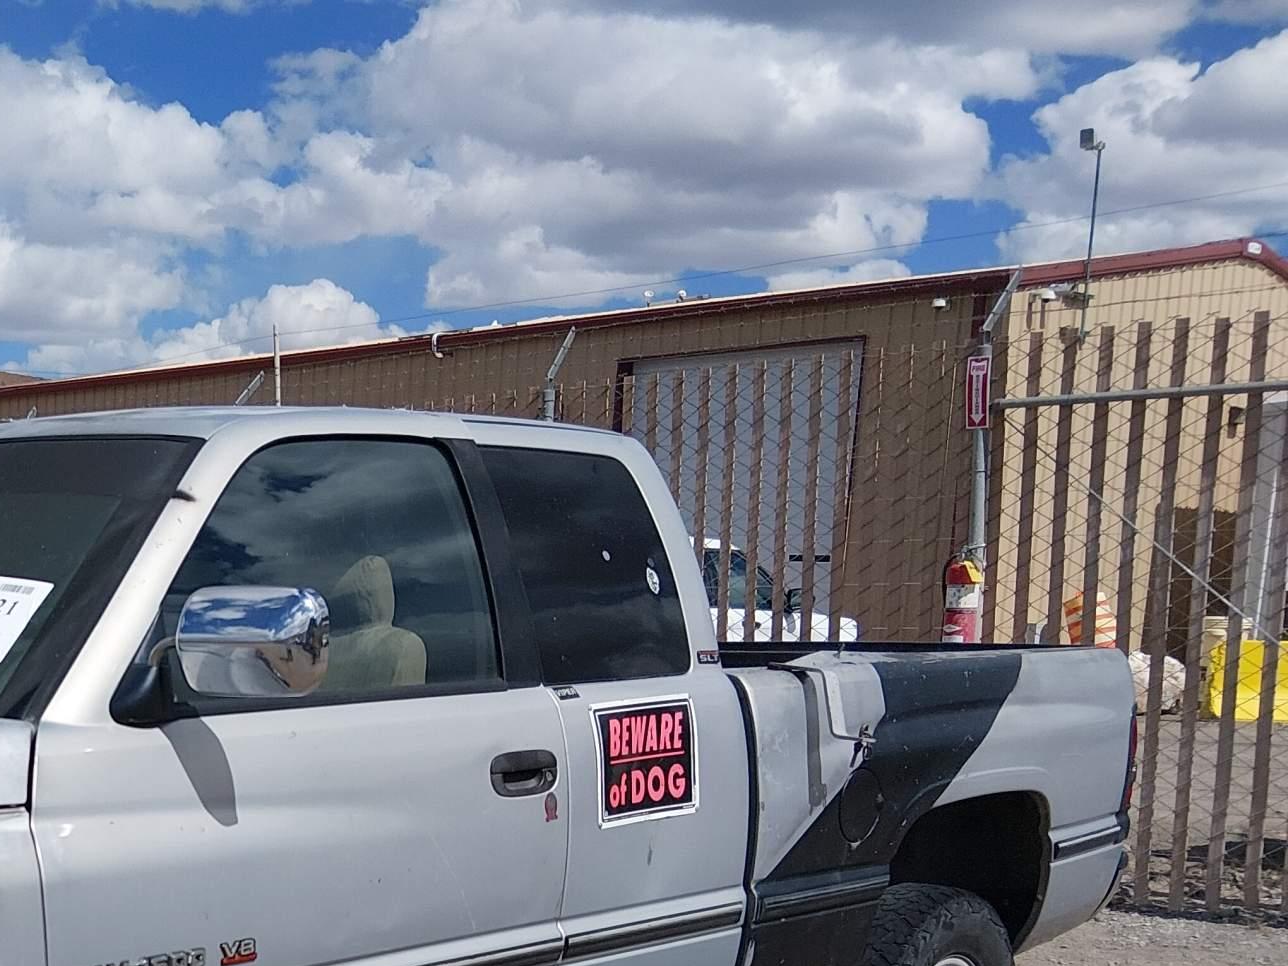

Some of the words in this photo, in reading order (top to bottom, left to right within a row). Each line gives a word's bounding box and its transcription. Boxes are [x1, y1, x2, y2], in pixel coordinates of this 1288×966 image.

[699, 654, 719, 662] SLT
[609, 711, 683, 758] BEWARE
[609, 772, 627, 808] of
[631, 763, 686, 804] DOG
[220, 938, 258, 962] V8
